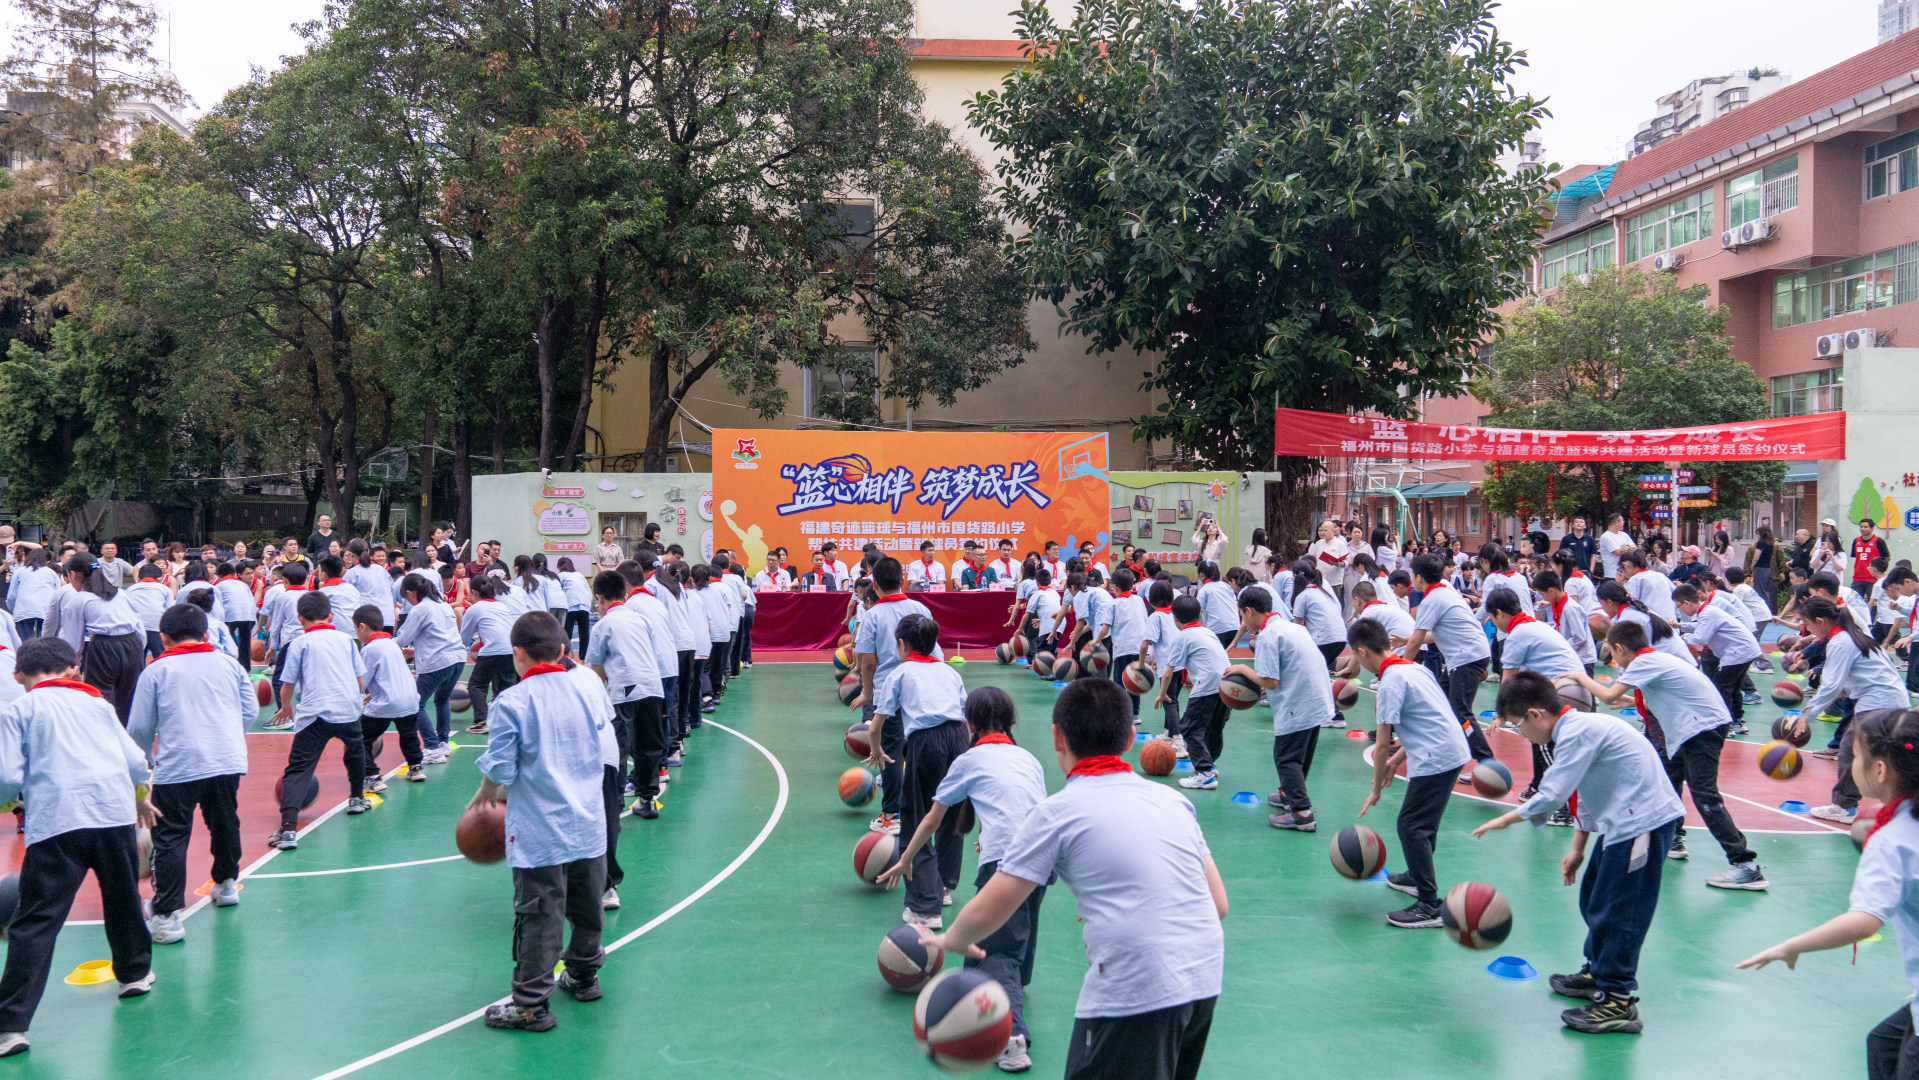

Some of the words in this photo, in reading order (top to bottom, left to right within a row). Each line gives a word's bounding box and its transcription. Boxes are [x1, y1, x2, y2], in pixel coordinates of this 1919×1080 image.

[920, 461, 1050, 518] 筑梦成长
[800, 520, 1026, 535] 福建奇迹篮球与福州市国货路小学
[1860, 553, 1868, 561] 12
